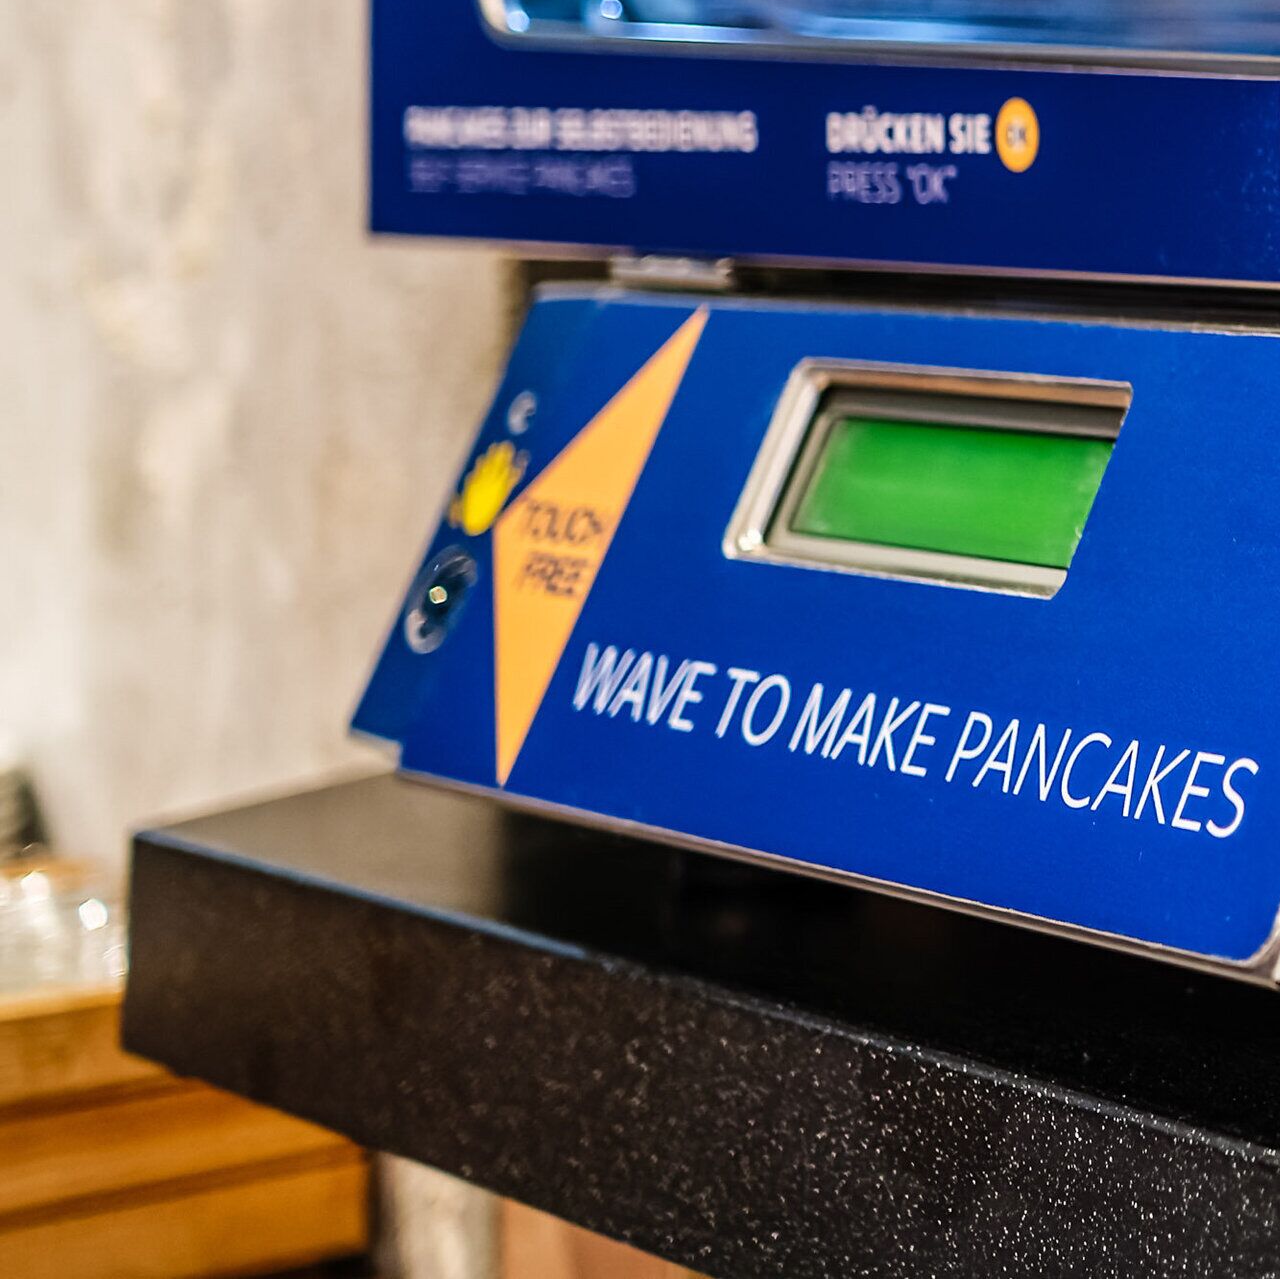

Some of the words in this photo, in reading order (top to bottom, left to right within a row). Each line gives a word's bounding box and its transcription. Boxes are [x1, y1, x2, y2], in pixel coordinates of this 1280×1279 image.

[948, 112, 992, 154] SIE
[826, 160, 902, 204] PRESS
[572, 641, 718, 733] WAVE
[714, 666, 791, 747] TO
[788, 682, 951, 778] MAKE
[944, 710, 1260, 839] PANCAKES
